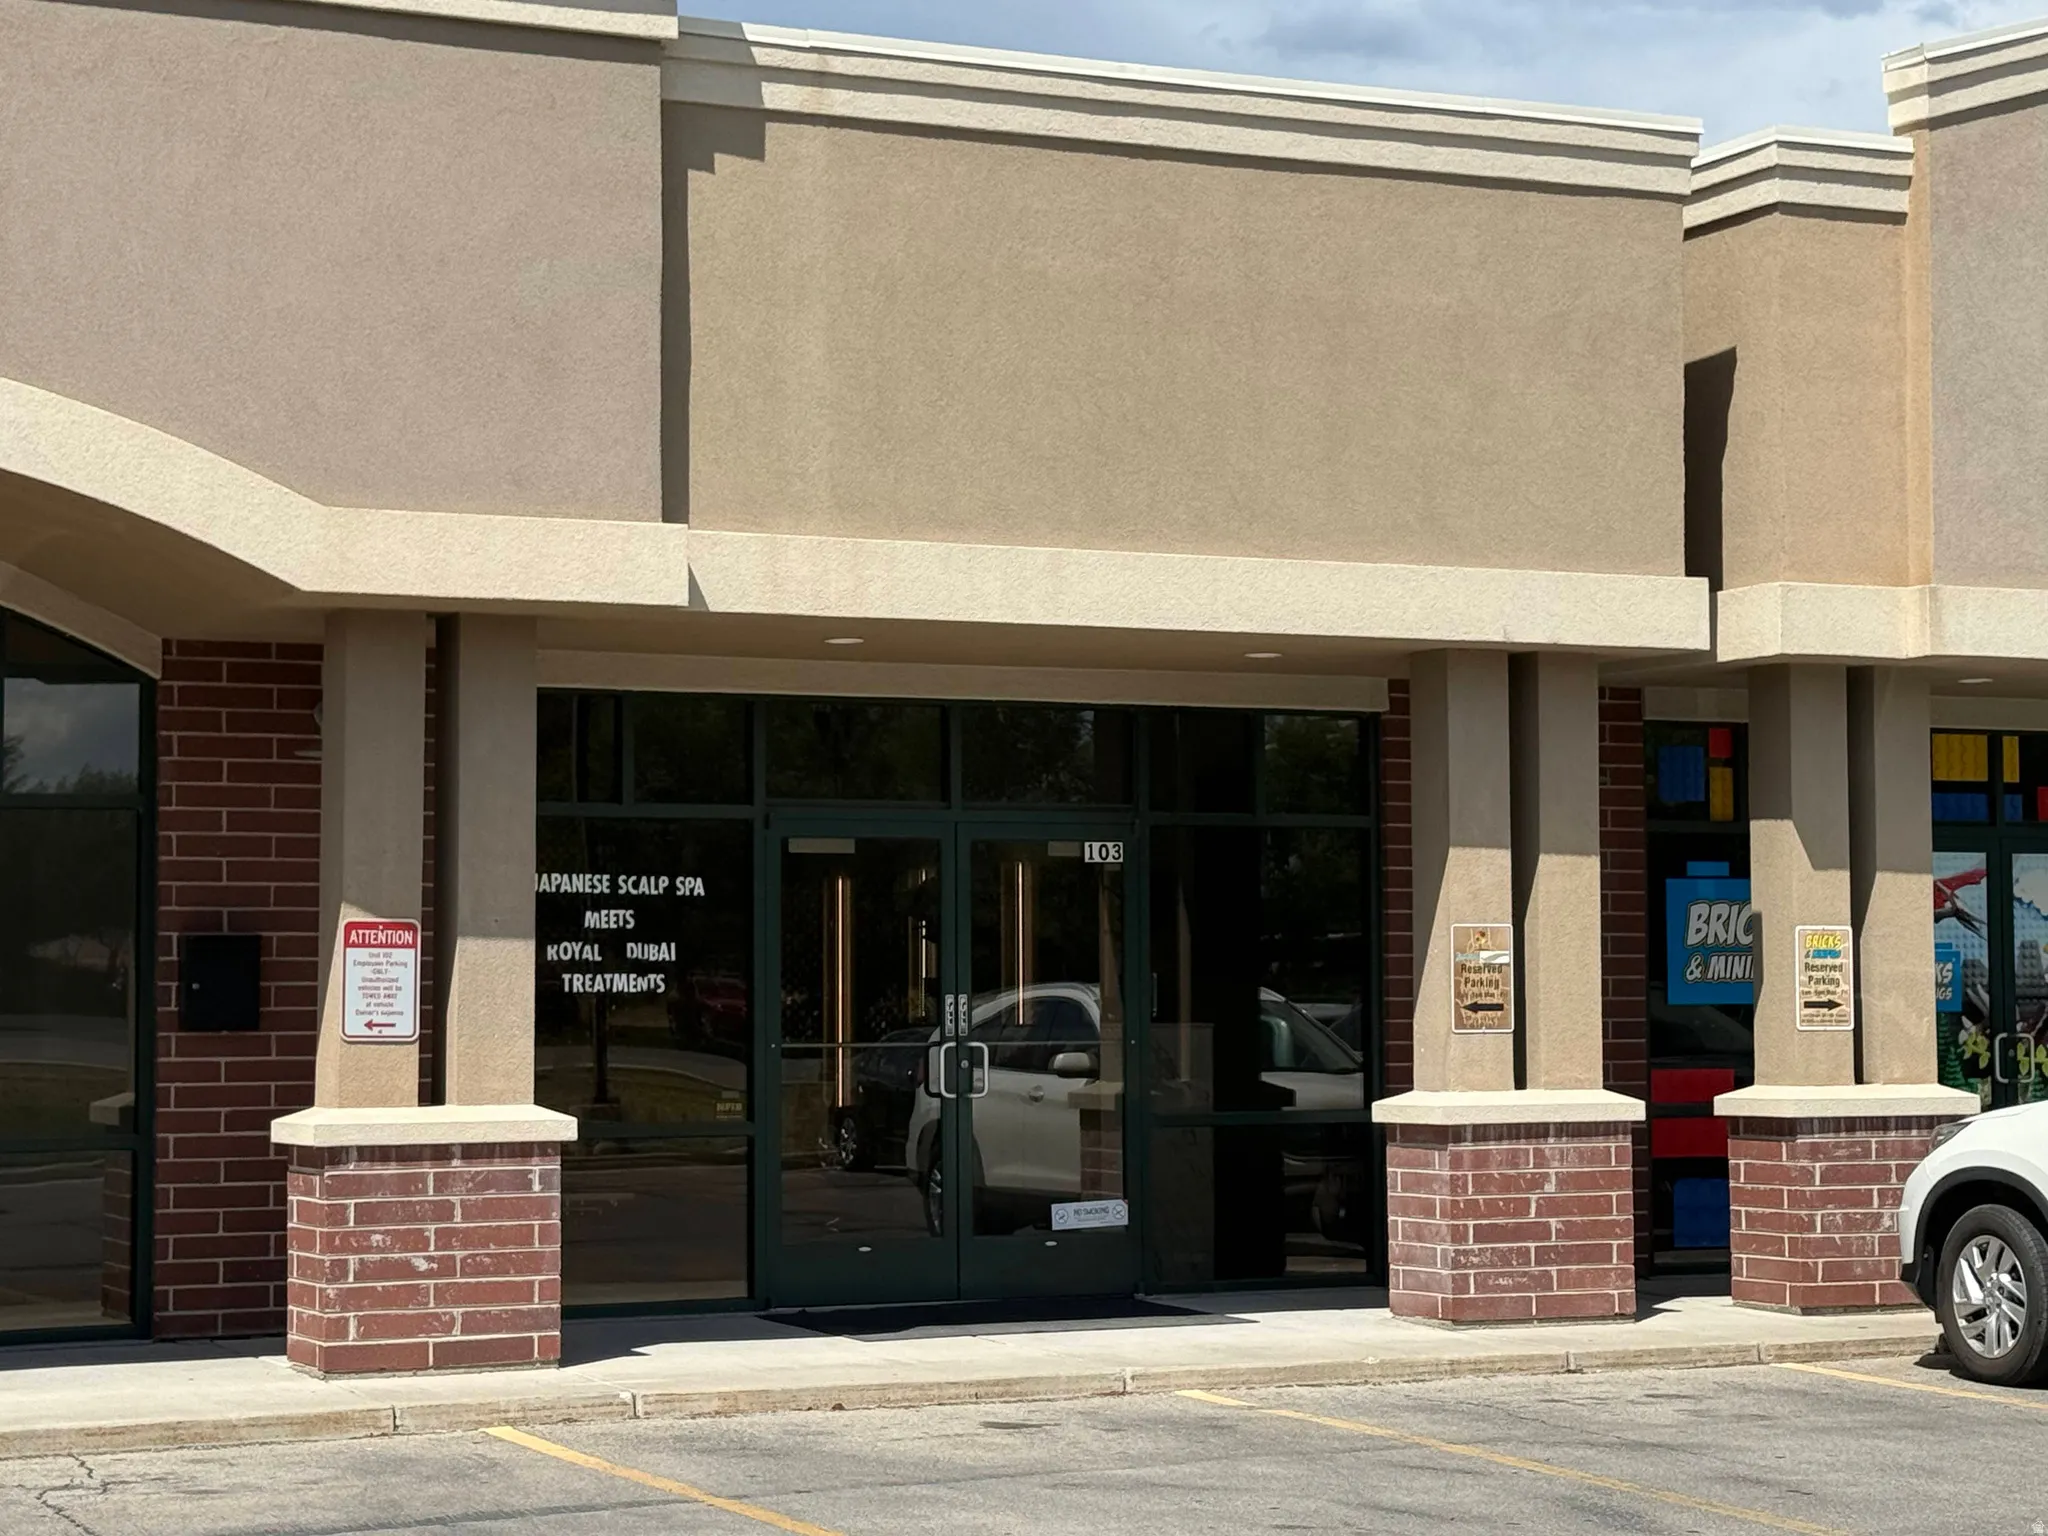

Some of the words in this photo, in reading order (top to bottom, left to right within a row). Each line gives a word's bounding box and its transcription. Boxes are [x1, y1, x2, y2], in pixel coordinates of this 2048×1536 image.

[1088, 843, 1122, 861] 103
[535, 873, 611, 894] JAPANESE
[618, 875, 669, 895] SCALP
[676, 876, 706, 896] SPA
[584, 909, 635, 929] MEETS
[349, 929, 414, 945] ATTENTION
[1804, 934, 1842, 949] BRICKS
[626, 942, 676, 961] DUBAI
[1460, 963, 1503, 974] Reserved
[1684, 952, 1703, 983] &
[1705, 953, 1754, 982] MINI
[1804, 962, 1843, 973] Reserved
[562, 973, 665, 993] TREATMENTS
[1464, 976, 1500, 990] Parking
[1808, 975, 1840, 988] Parking
